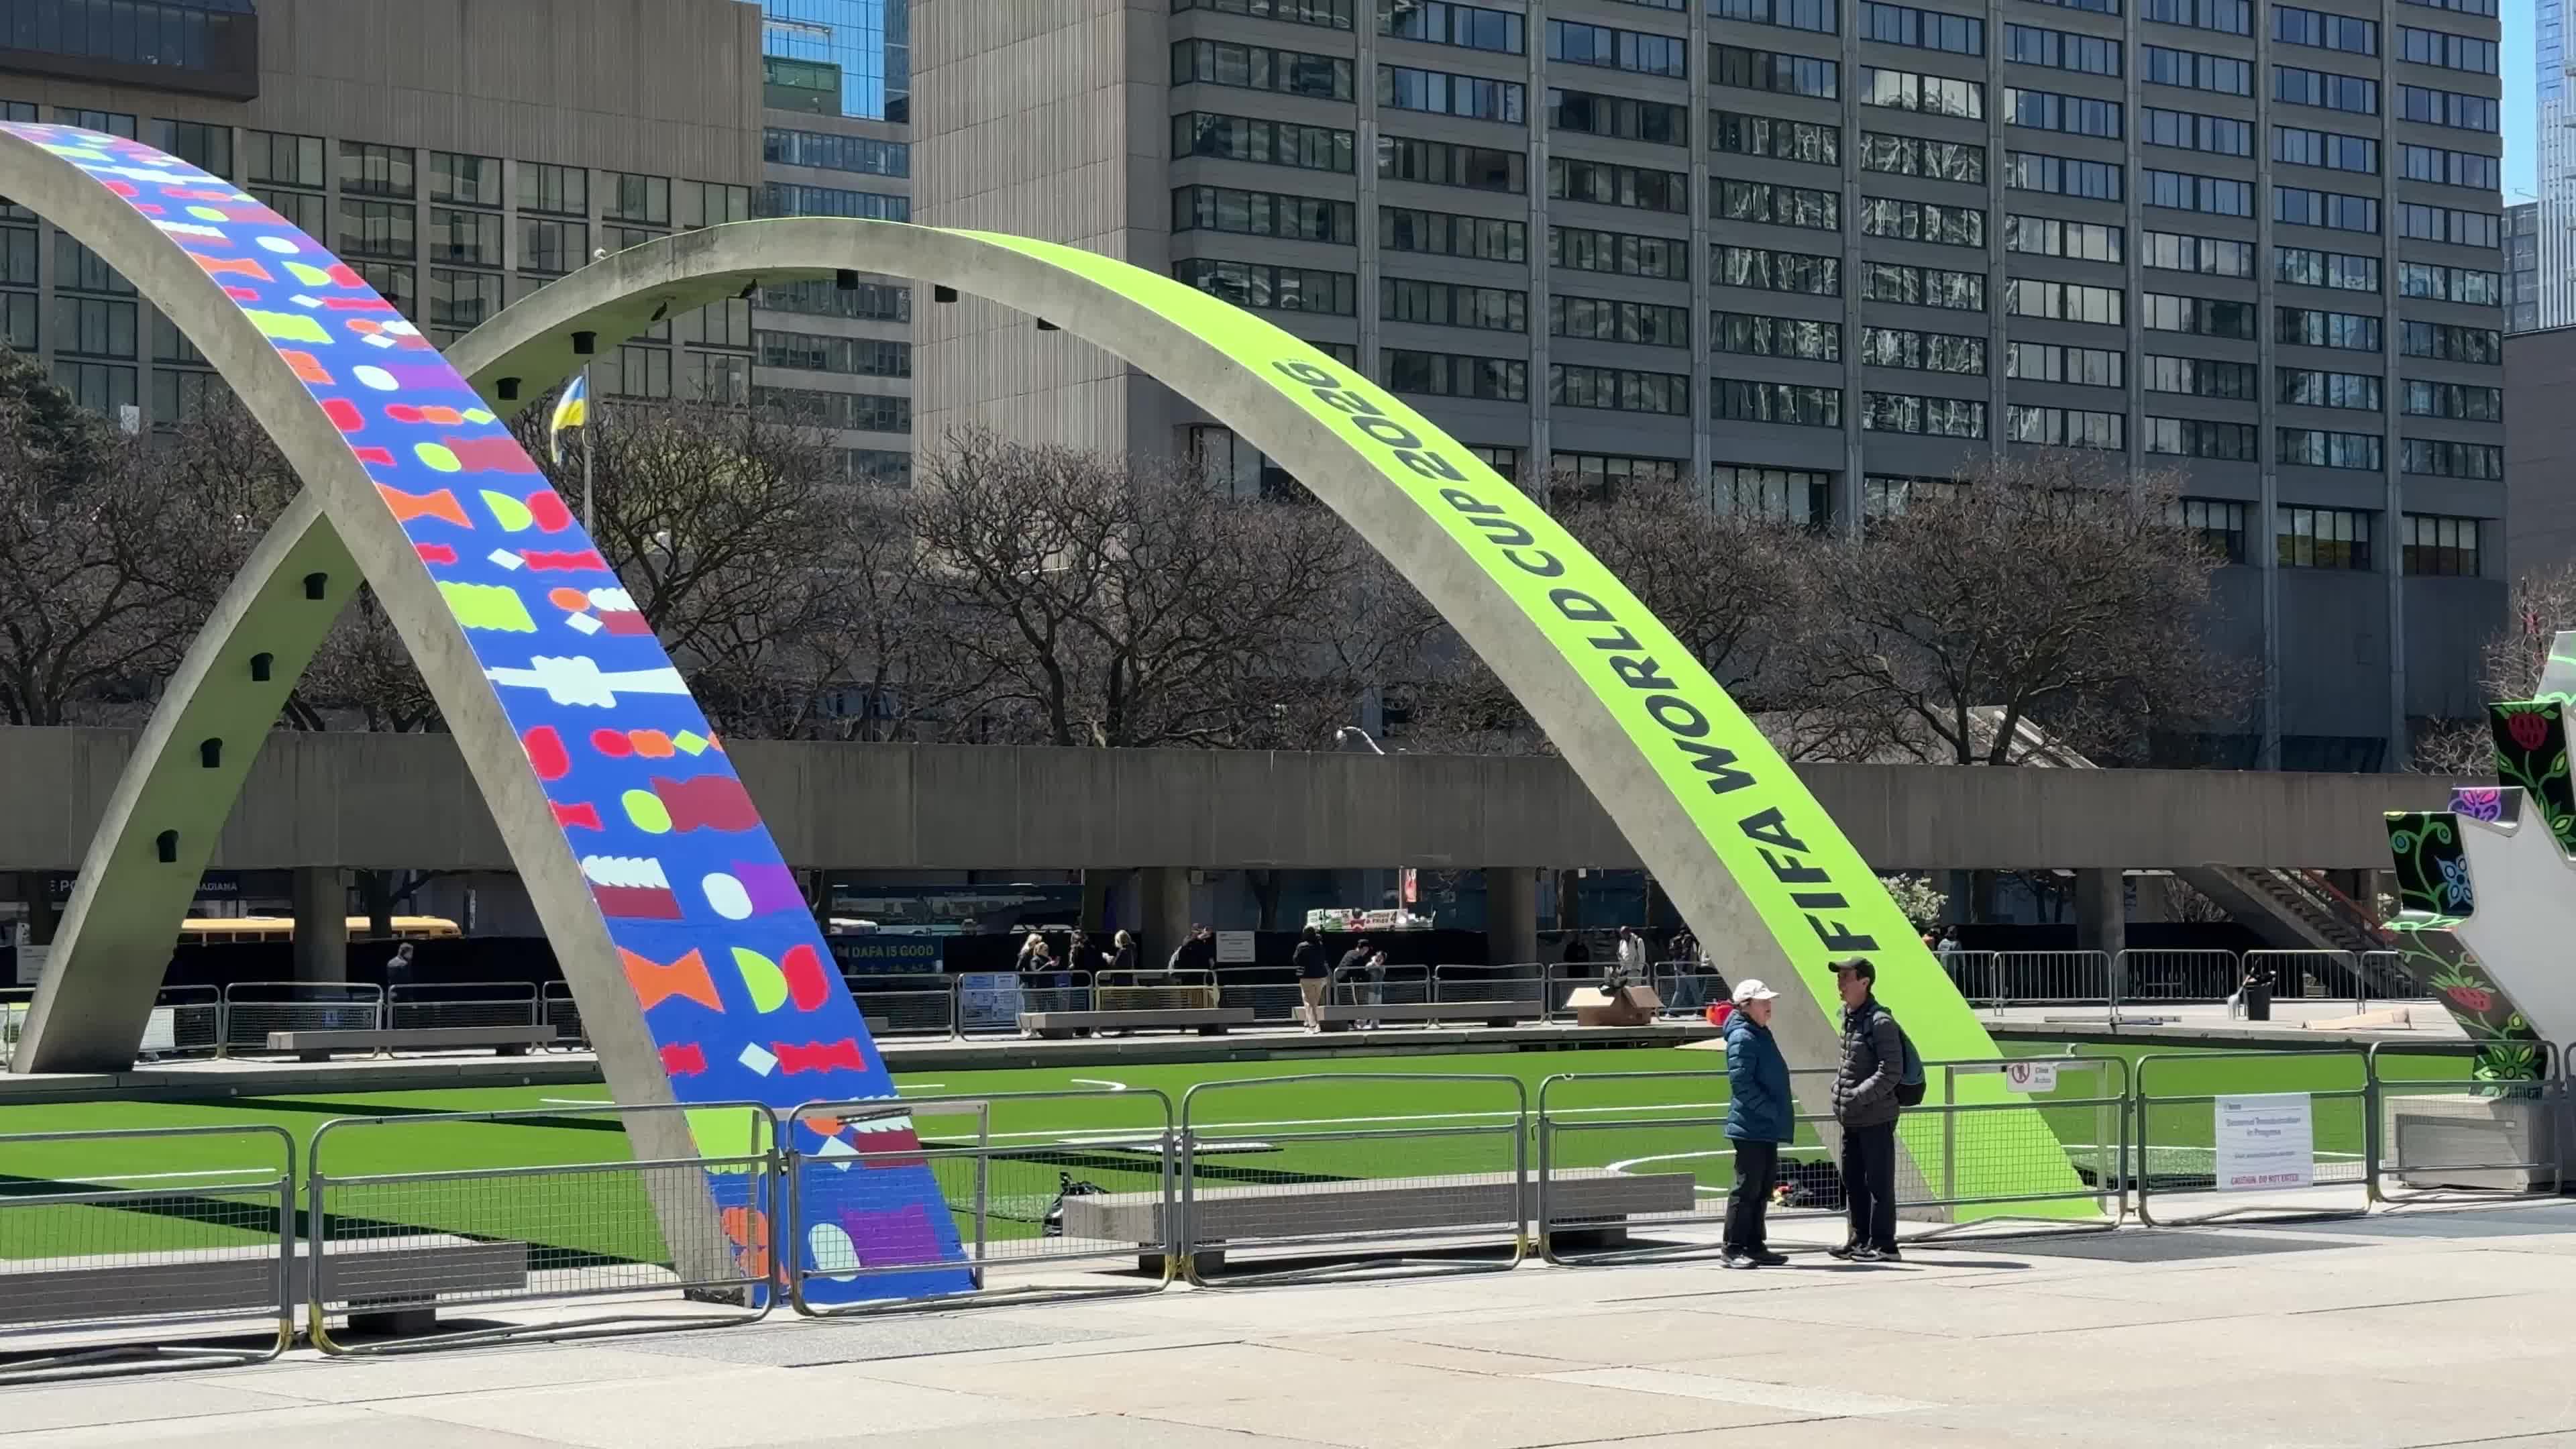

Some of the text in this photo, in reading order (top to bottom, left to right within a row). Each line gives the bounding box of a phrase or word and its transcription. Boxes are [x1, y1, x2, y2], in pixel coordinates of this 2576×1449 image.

[1271, 361, 1881, 951] FIFA WORLD CUP 2026
[852, 945, 884, 957] DAFA
[900, 945, 934, 956] GOOD
